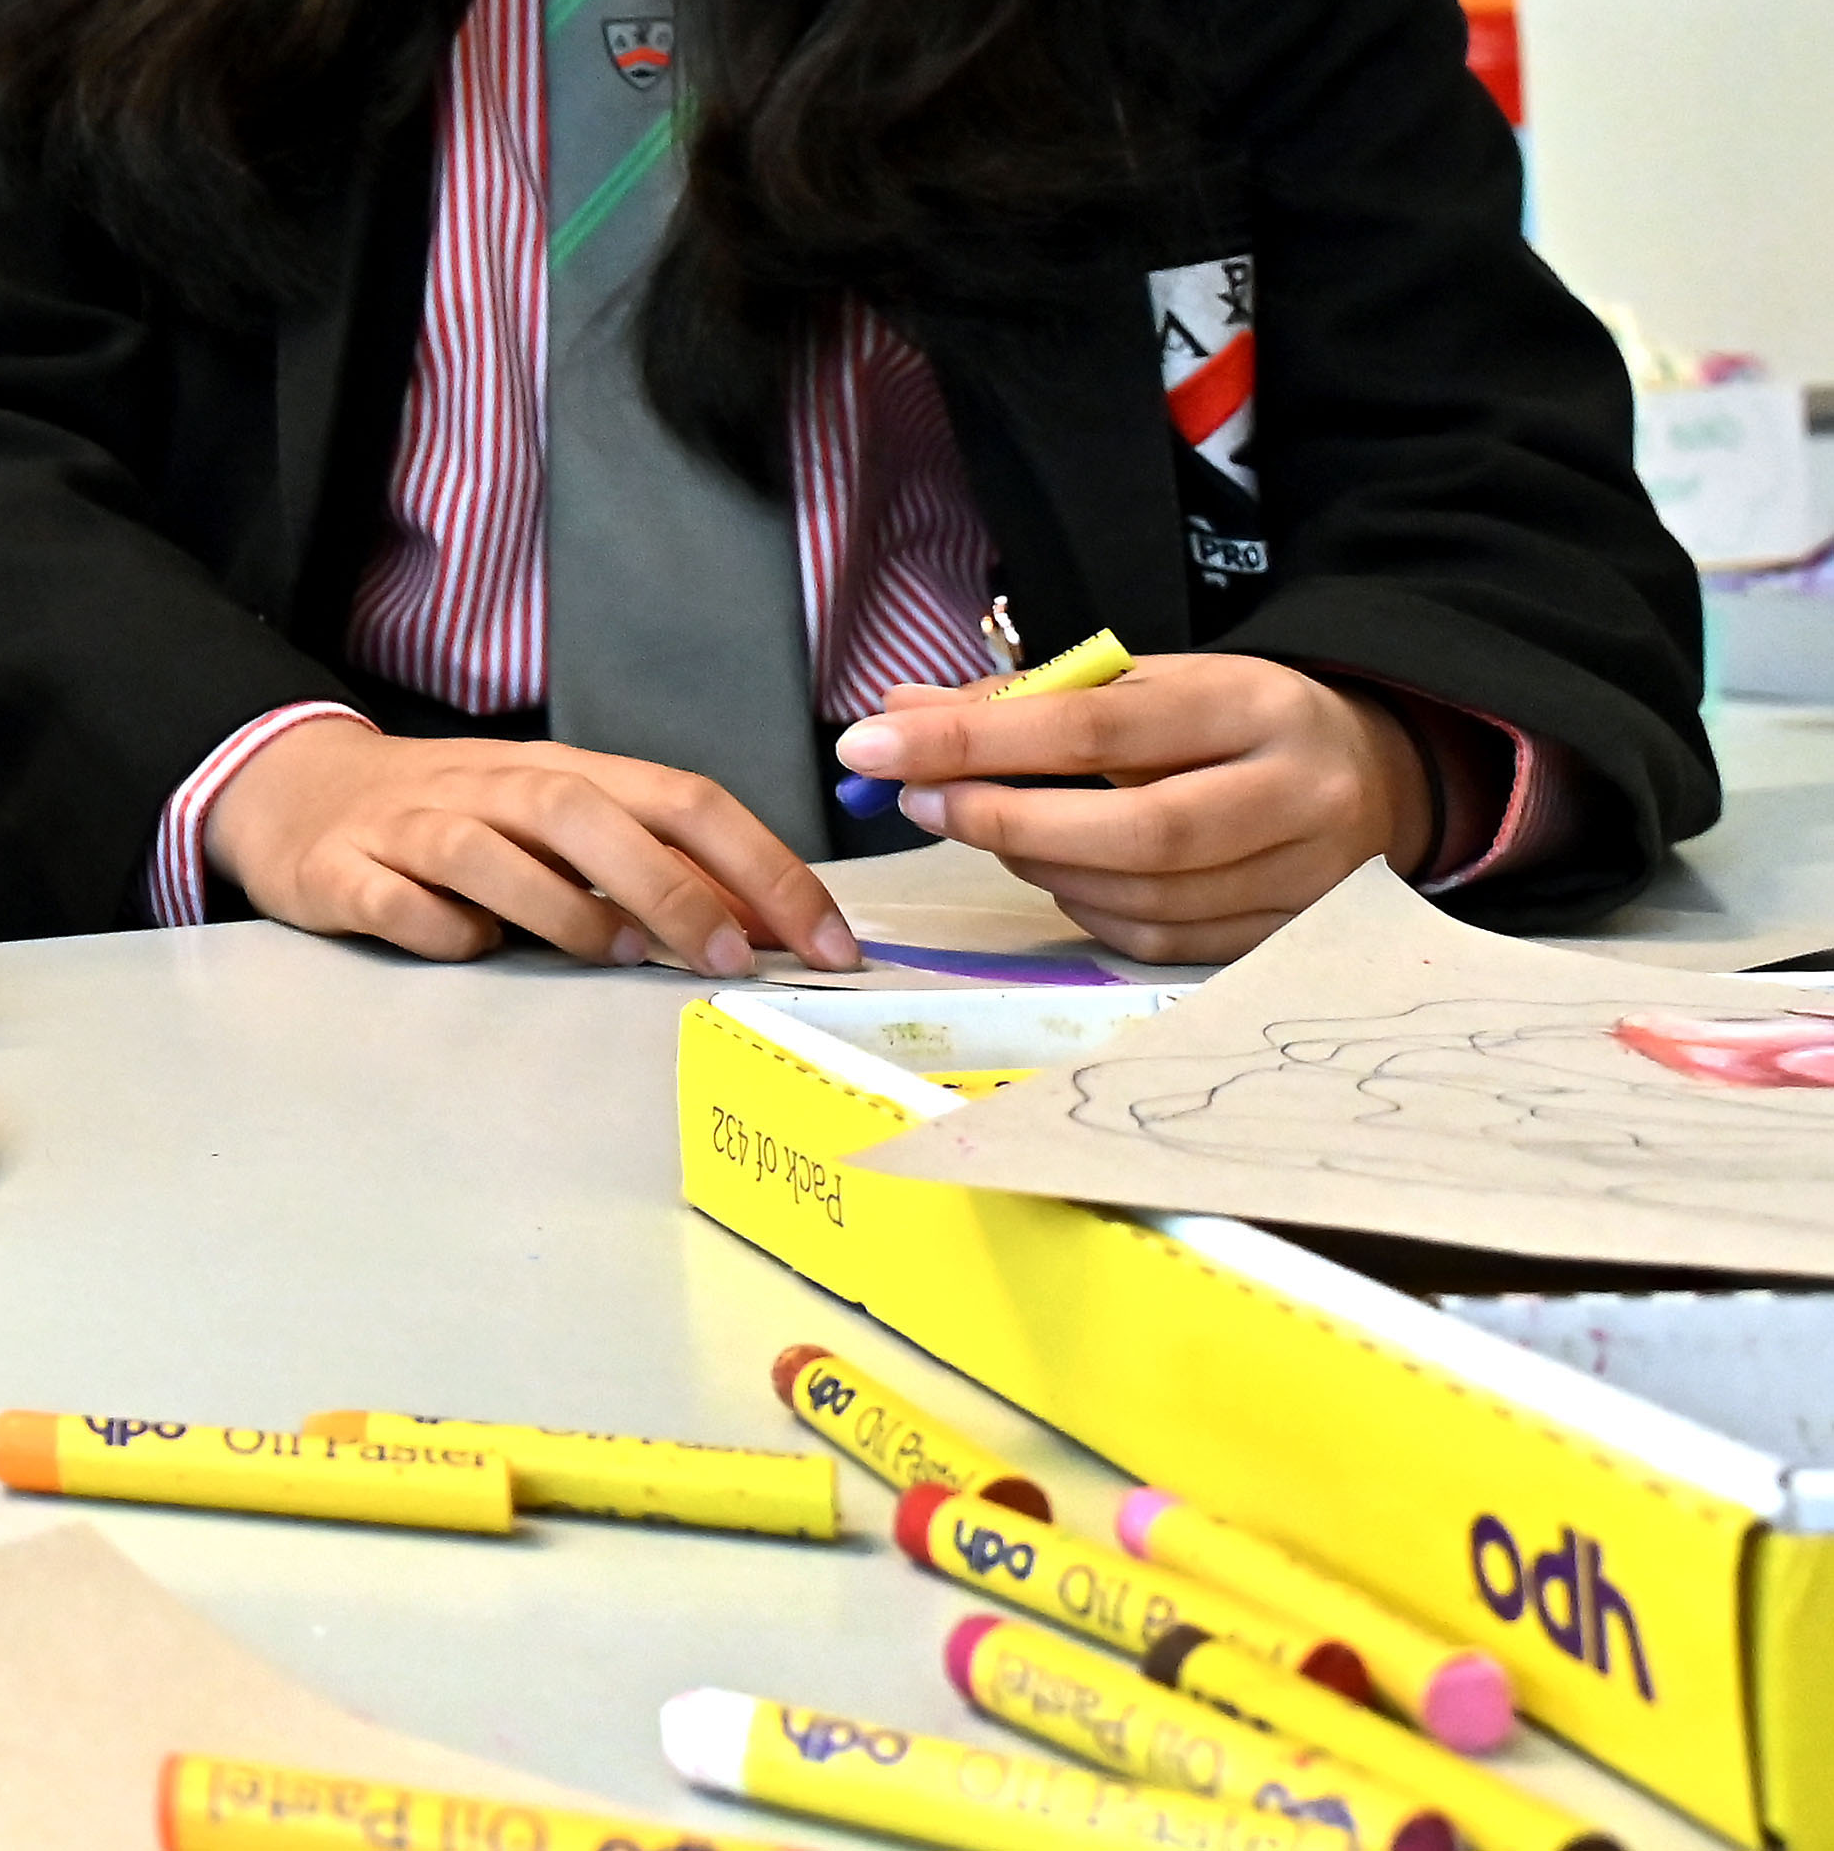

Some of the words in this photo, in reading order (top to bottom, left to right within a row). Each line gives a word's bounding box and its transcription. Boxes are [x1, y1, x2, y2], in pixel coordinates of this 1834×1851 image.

[712, 1106, 749, 1166] 432
[755, 1131, 778, 1183] of
[784, 1146, 844, 1228] Pack
